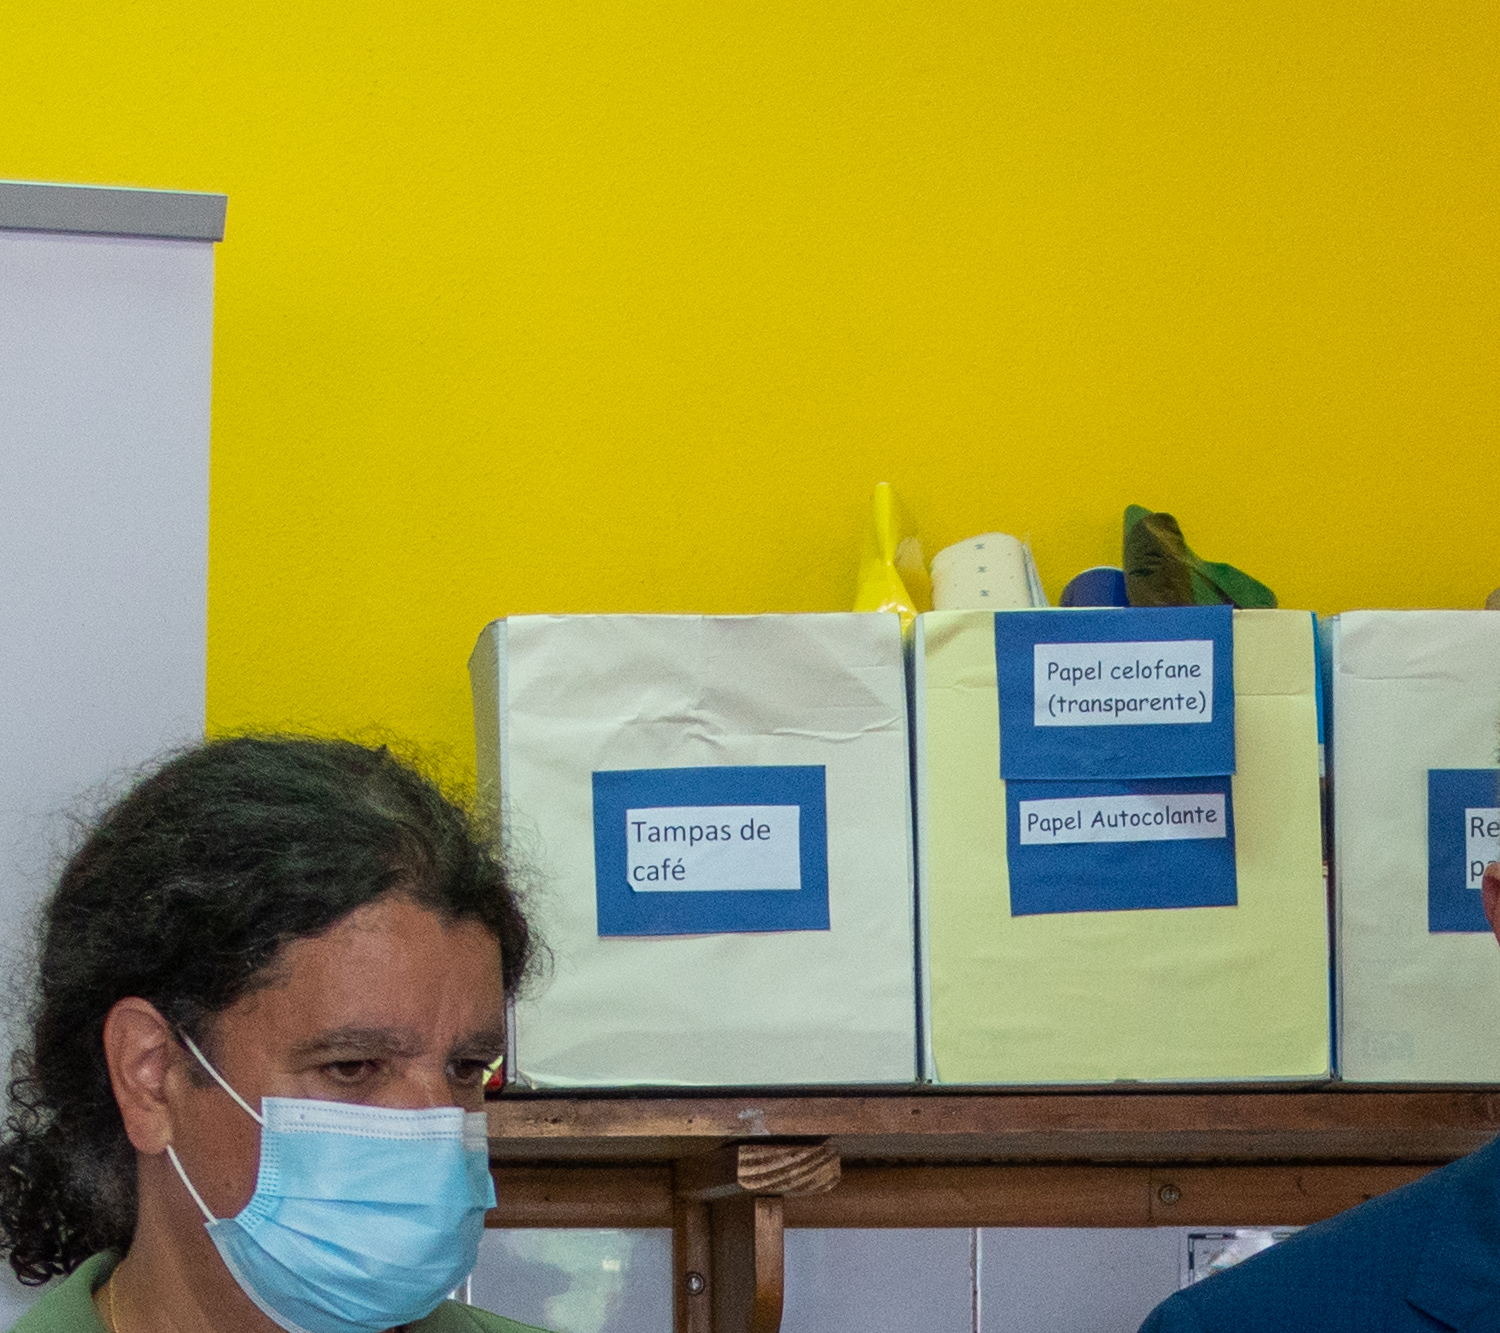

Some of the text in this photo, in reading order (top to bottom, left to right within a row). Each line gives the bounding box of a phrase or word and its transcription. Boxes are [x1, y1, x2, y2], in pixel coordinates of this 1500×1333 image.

[1046, 656, 1203, 687] Papel celofane
[1047, 690, 1207, 718] (transparente)
[630, 816, 772, 848] Tampas de
[1026, 801, 1218, 837] Papel Autocolante
[1470, 815, 1500, 838] Re
[631, 854, 686, 883] café
